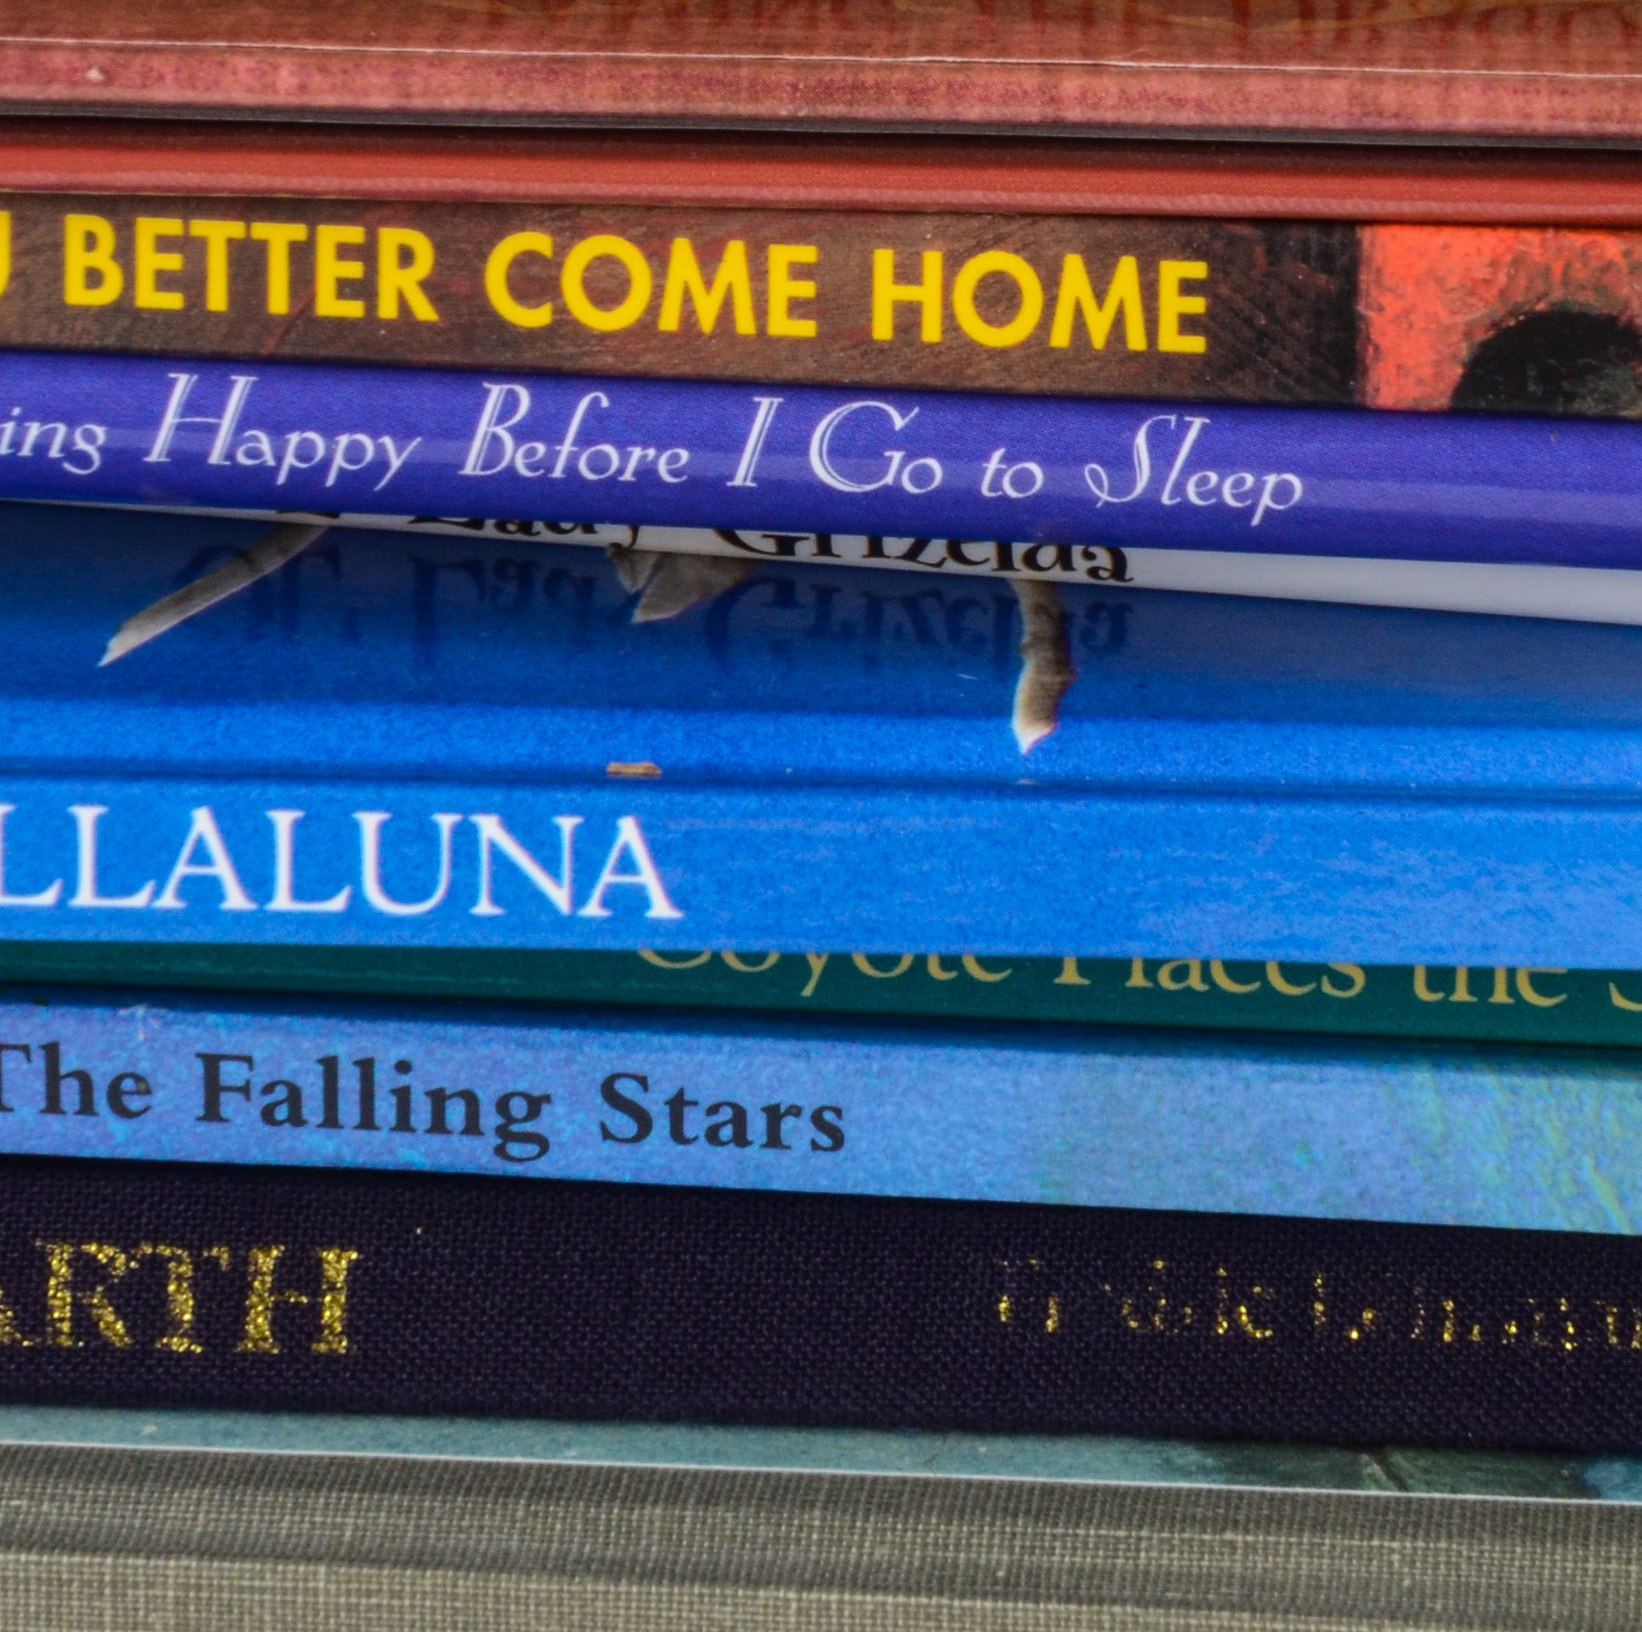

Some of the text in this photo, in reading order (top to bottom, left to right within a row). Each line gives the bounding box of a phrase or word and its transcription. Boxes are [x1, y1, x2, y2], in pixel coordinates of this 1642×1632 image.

[65, 214, 440, 323] BETTER
[485, 231, 818, 338] COME
[872, 248, 1209, 354] HOME
[144, 373, 423, 491] Happy
[458, 382, 691, 484] Before
[725, 395, 785, 489] I
[808, 398, 945, 498] Go
[981, 448, 1046, 501] to
[1085, 414, 1304, 527] Sleep
[195, 1049, 554, 1164] Falling
[597, 1072, 847, 1154] Stars
